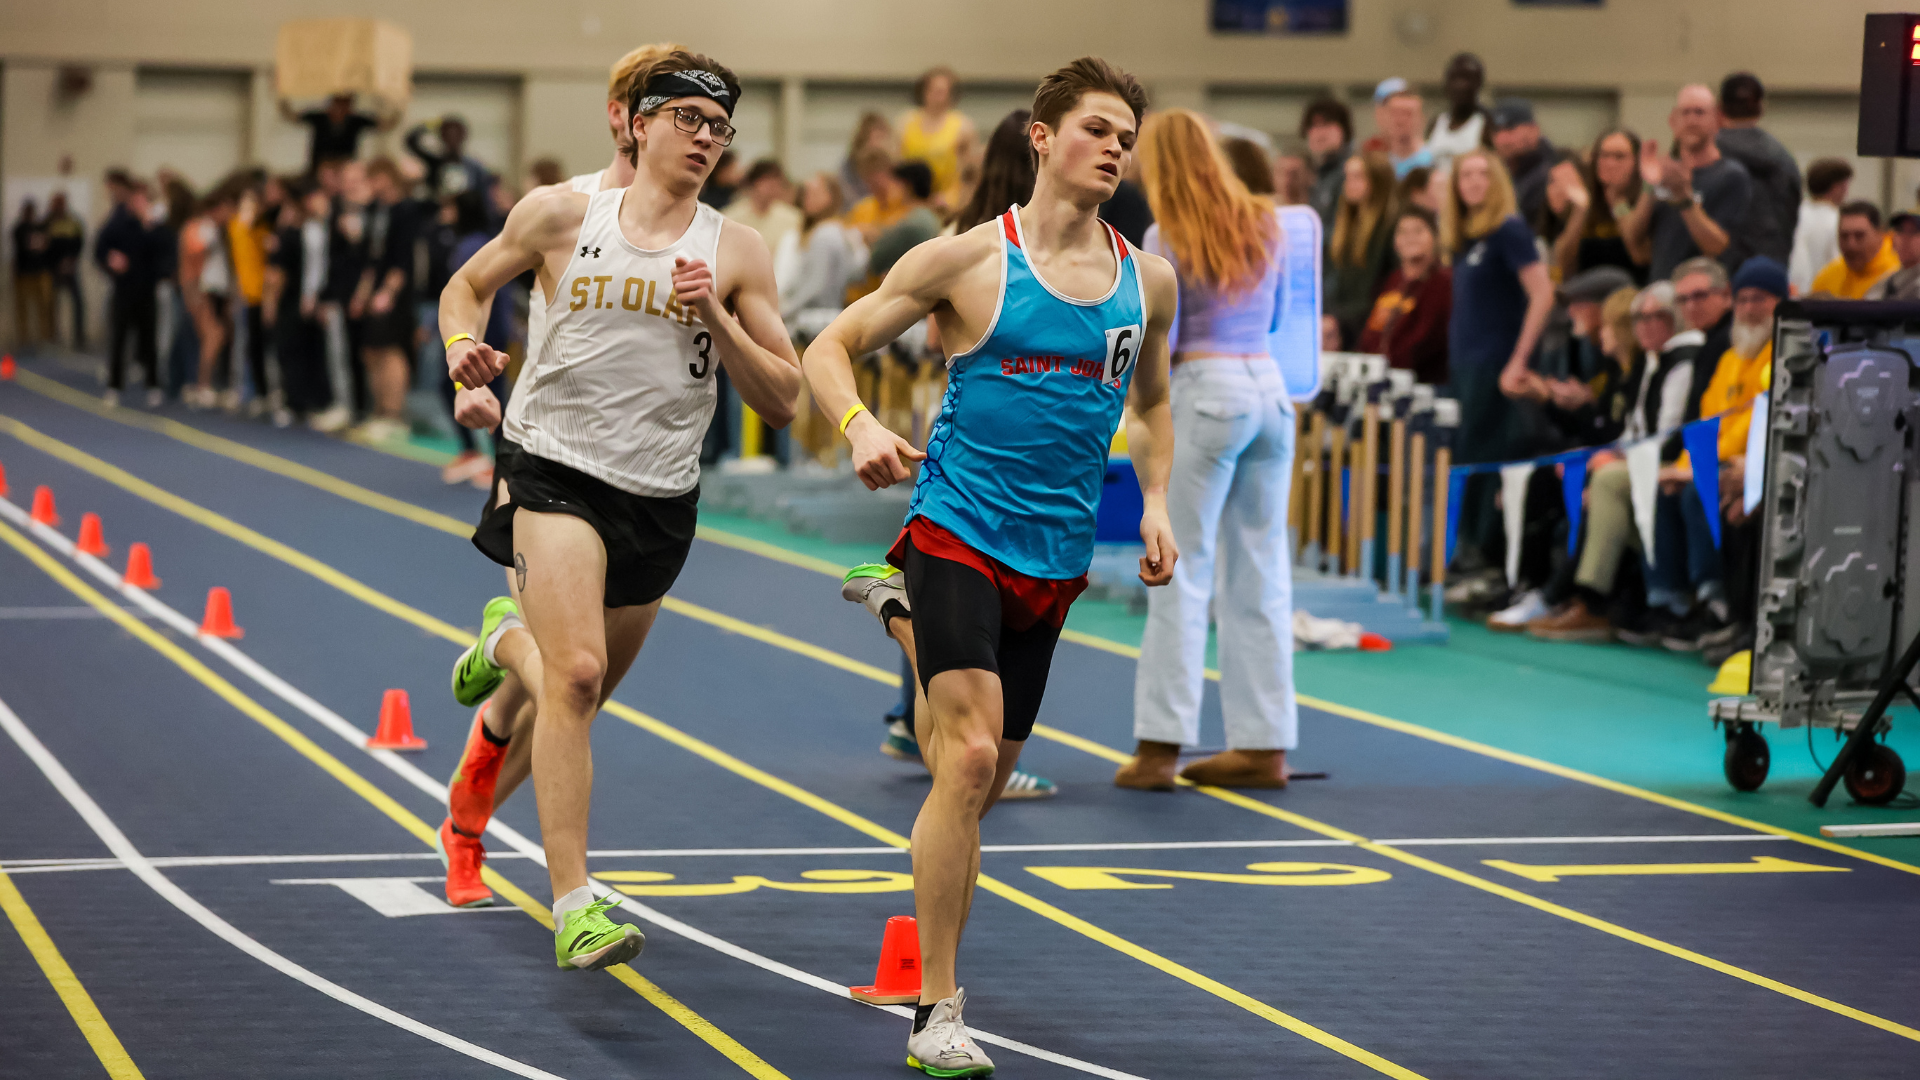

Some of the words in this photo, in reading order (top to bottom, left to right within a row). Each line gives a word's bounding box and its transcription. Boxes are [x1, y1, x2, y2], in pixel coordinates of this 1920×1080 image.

[569, 275, 613, 312] ST.
[688, 331, 712, 379] 3
[1000, 355, 1065, 376] SAINT
[1111, 329, 1132, 379] 6
[588, 869, 915, 896] 3
[1023, 861, 1393, 890] 2
